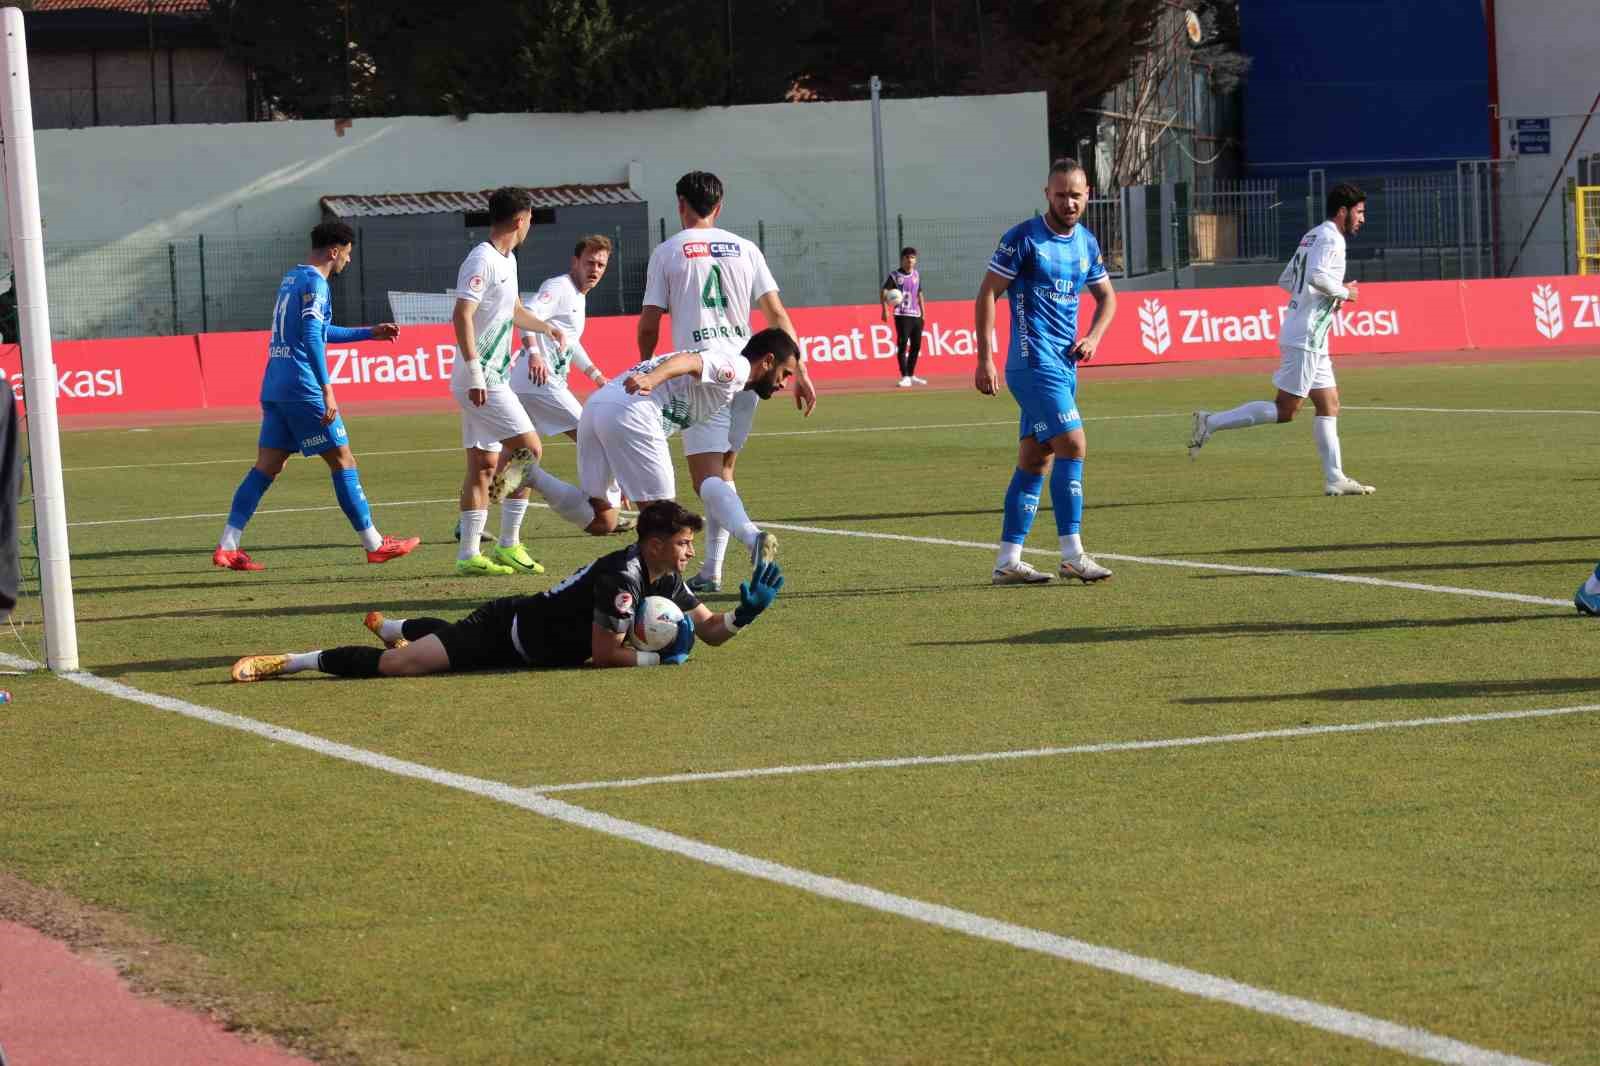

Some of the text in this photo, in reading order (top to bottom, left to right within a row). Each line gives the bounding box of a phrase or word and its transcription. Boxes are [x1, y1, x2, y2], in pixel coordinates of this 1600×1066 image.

[702, 264, 727, 308] 4
[1055, 279, 1073, 293] CIP
[1179, 308, 1276, 344] Ziraat
[799, 328, 868, 362] raat
[326, 347, 432, 385] Ziraat
